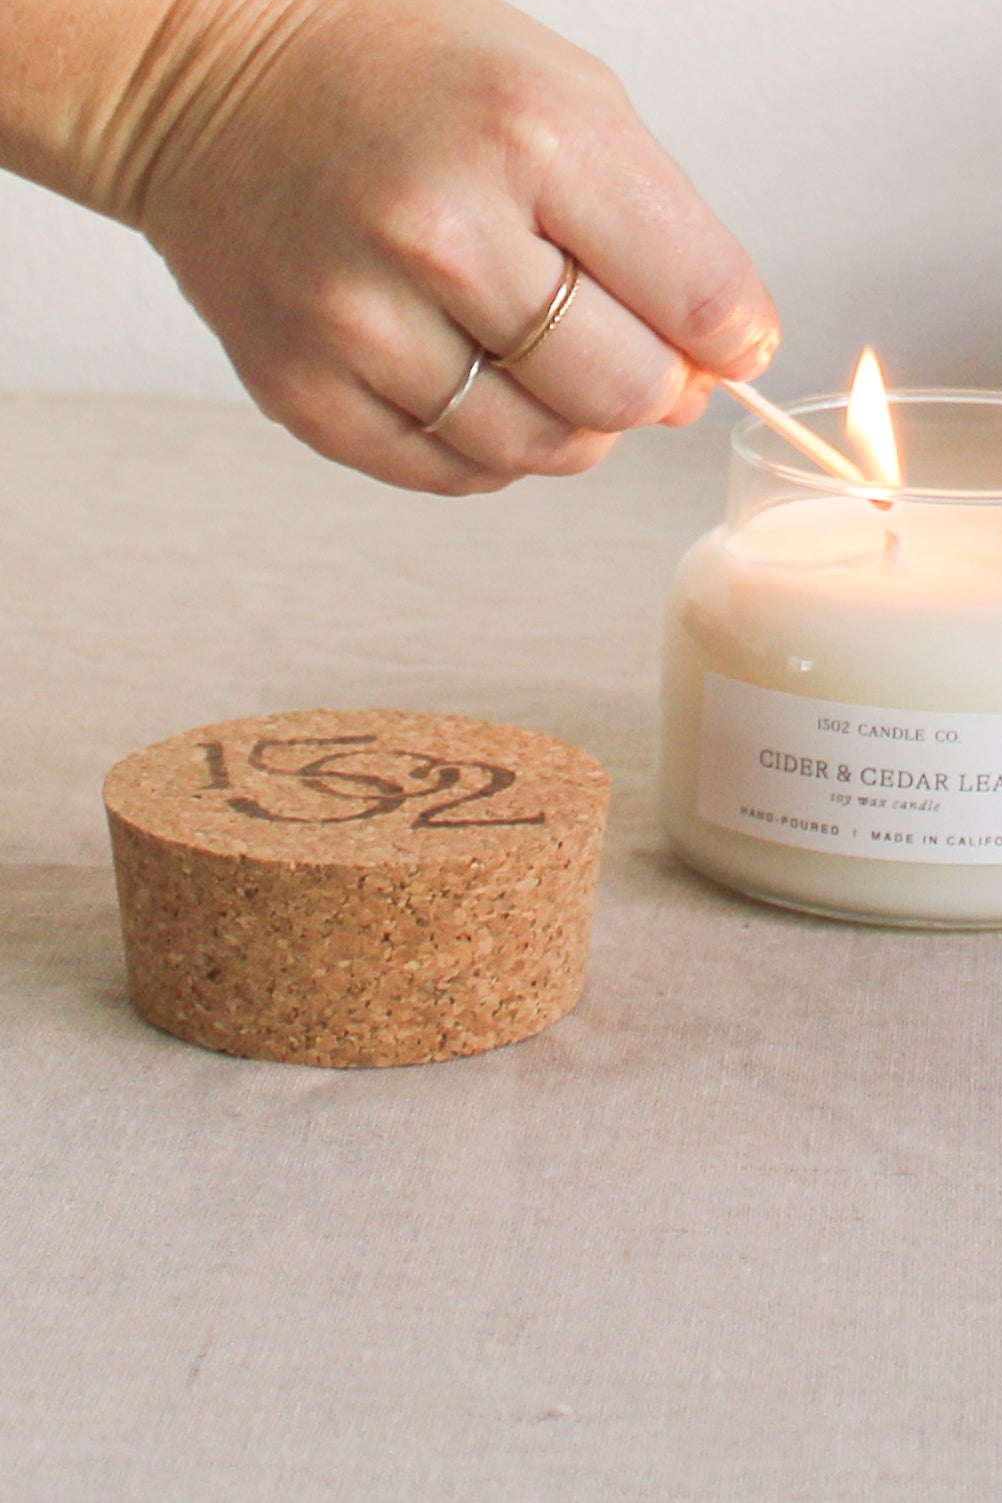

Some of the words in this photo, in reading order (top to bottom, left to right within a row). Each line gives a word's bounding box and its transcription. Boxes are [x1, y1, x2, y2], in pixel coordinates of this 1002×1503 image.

[817, 717, 850, 735] 1502
[857, 723, 926, 742] CANDLE
[759, 748, 829, 780] CIDER
[836, 763, 852, 783] &
[860, 767, 949, 791] CEDAR
[857, 796, 888, 808] wax
[891, 799, 942, 813] candle
[740, 805, 840, 836] HAND-POURED
[871, 830, 914, 844] MADE
[922, 835, 938, 845] IN
